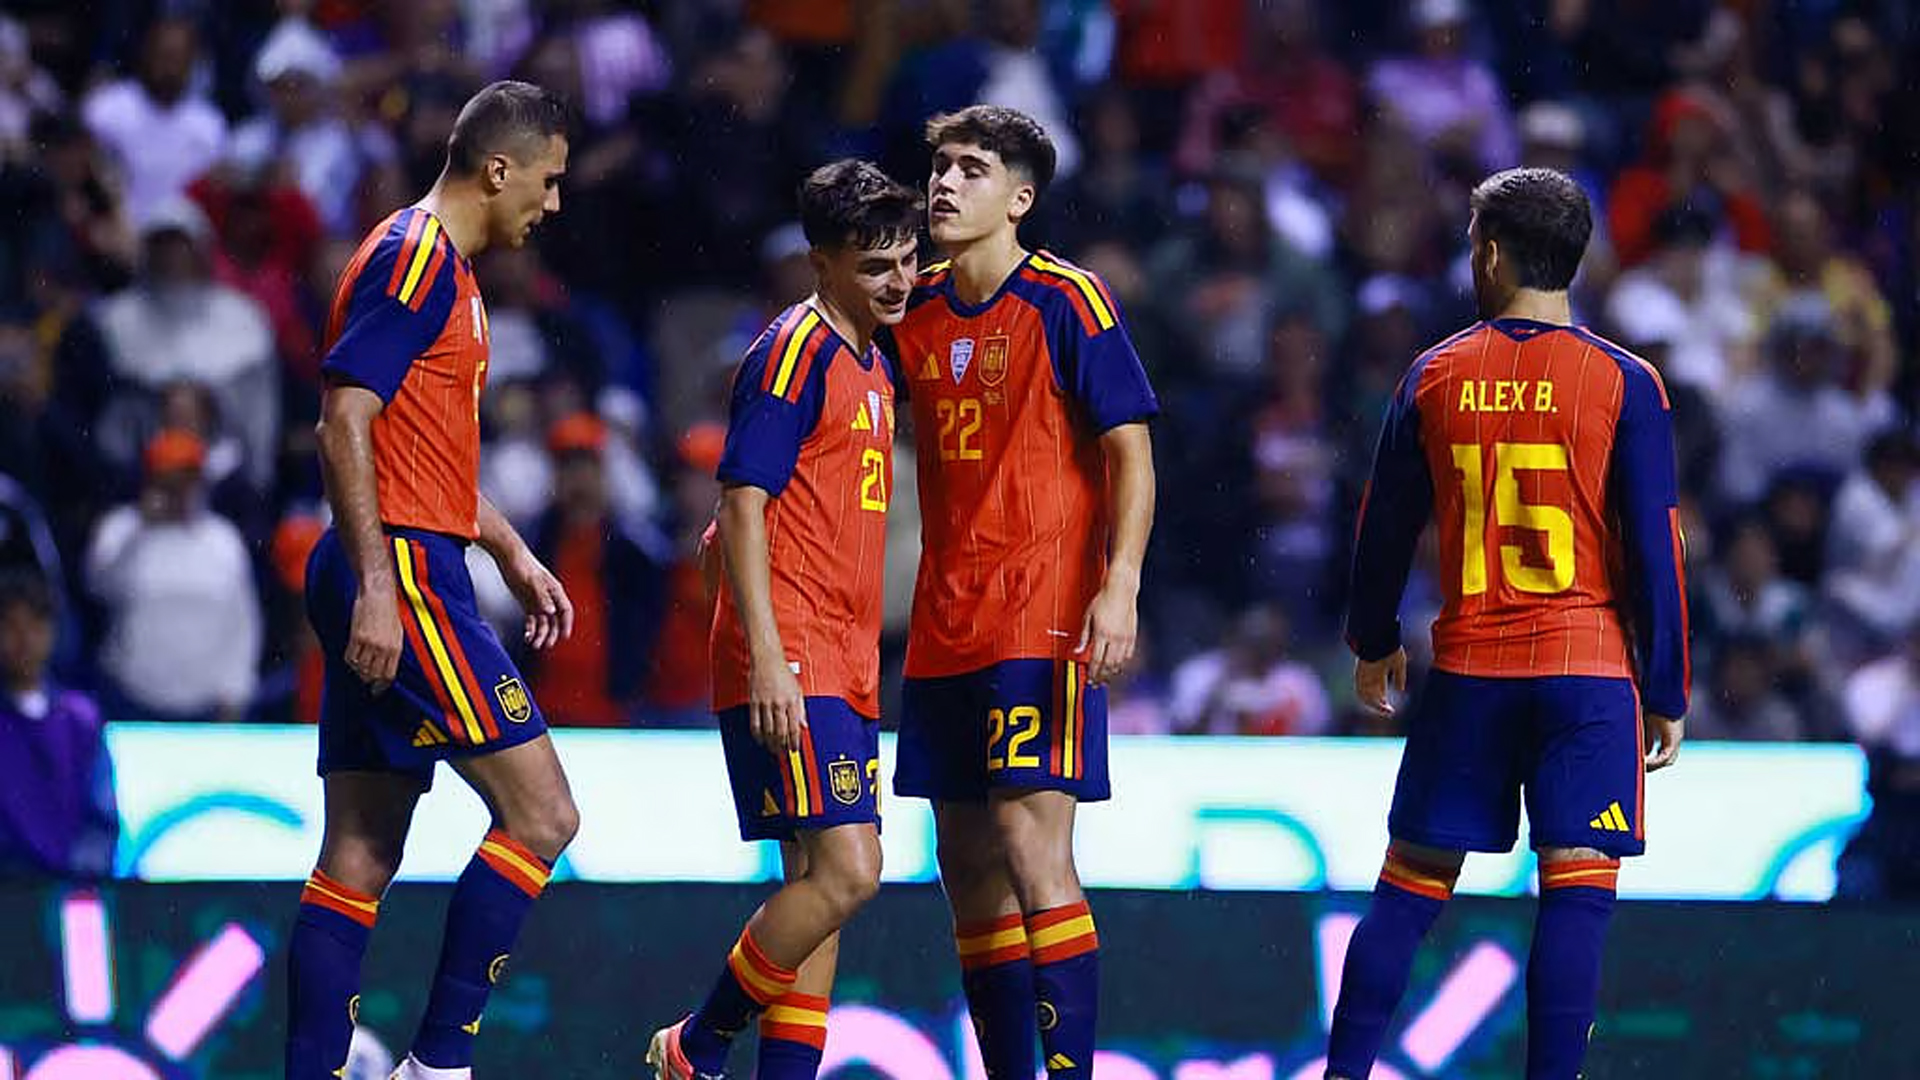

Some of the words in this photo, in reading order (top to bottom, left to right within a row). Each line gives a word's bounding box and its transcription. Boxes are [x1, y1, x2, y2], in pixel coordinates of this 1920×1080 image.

[1458, 380, 1529, 412] ALEX
[1534, 380, 1558, 413] B.
[937, 398, 982, 461] 22
[1451, 442, 1576, 595] 15
